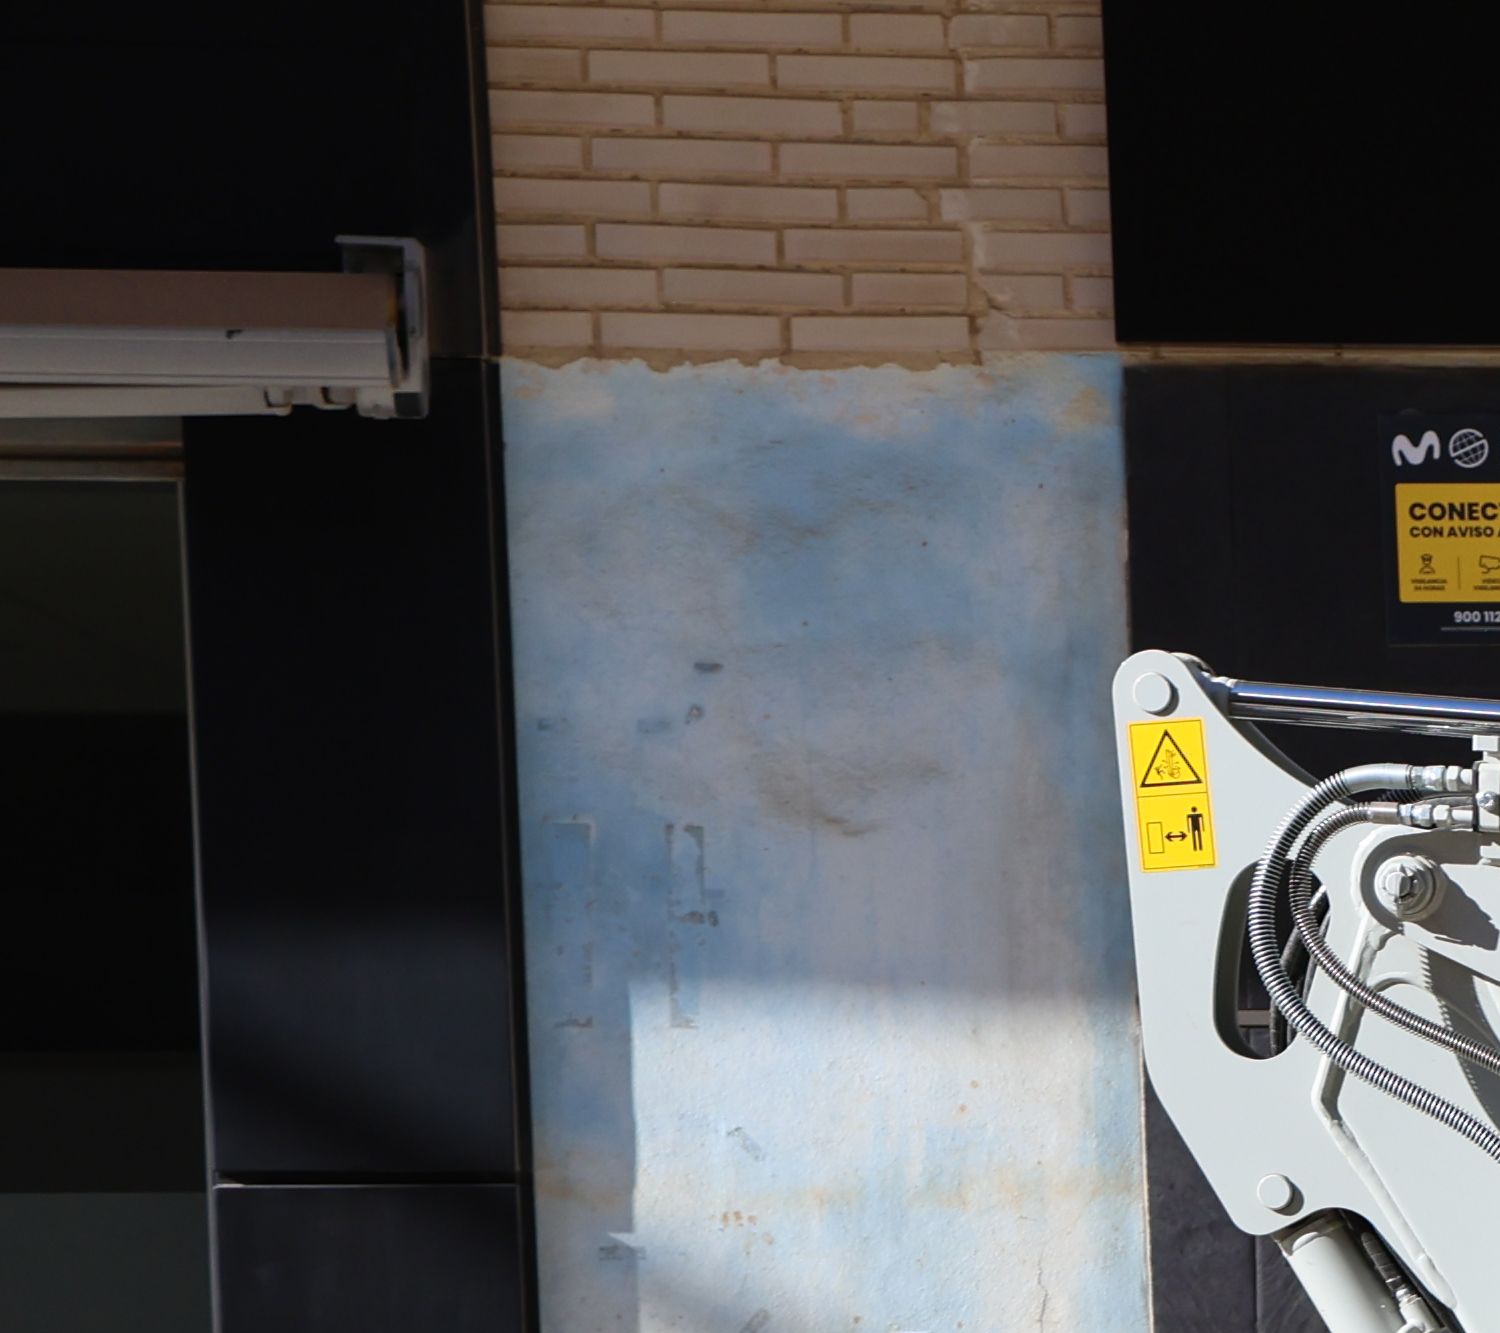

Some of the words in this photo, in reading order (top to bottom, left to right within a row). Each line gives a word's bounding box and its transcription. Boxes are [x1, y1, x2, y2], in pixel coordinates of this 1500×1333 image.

[1409, 525, 1444, 538] CON
[1447, 525, 1494, 538] AVISO
[1454, 611, 1481, 623] 900
